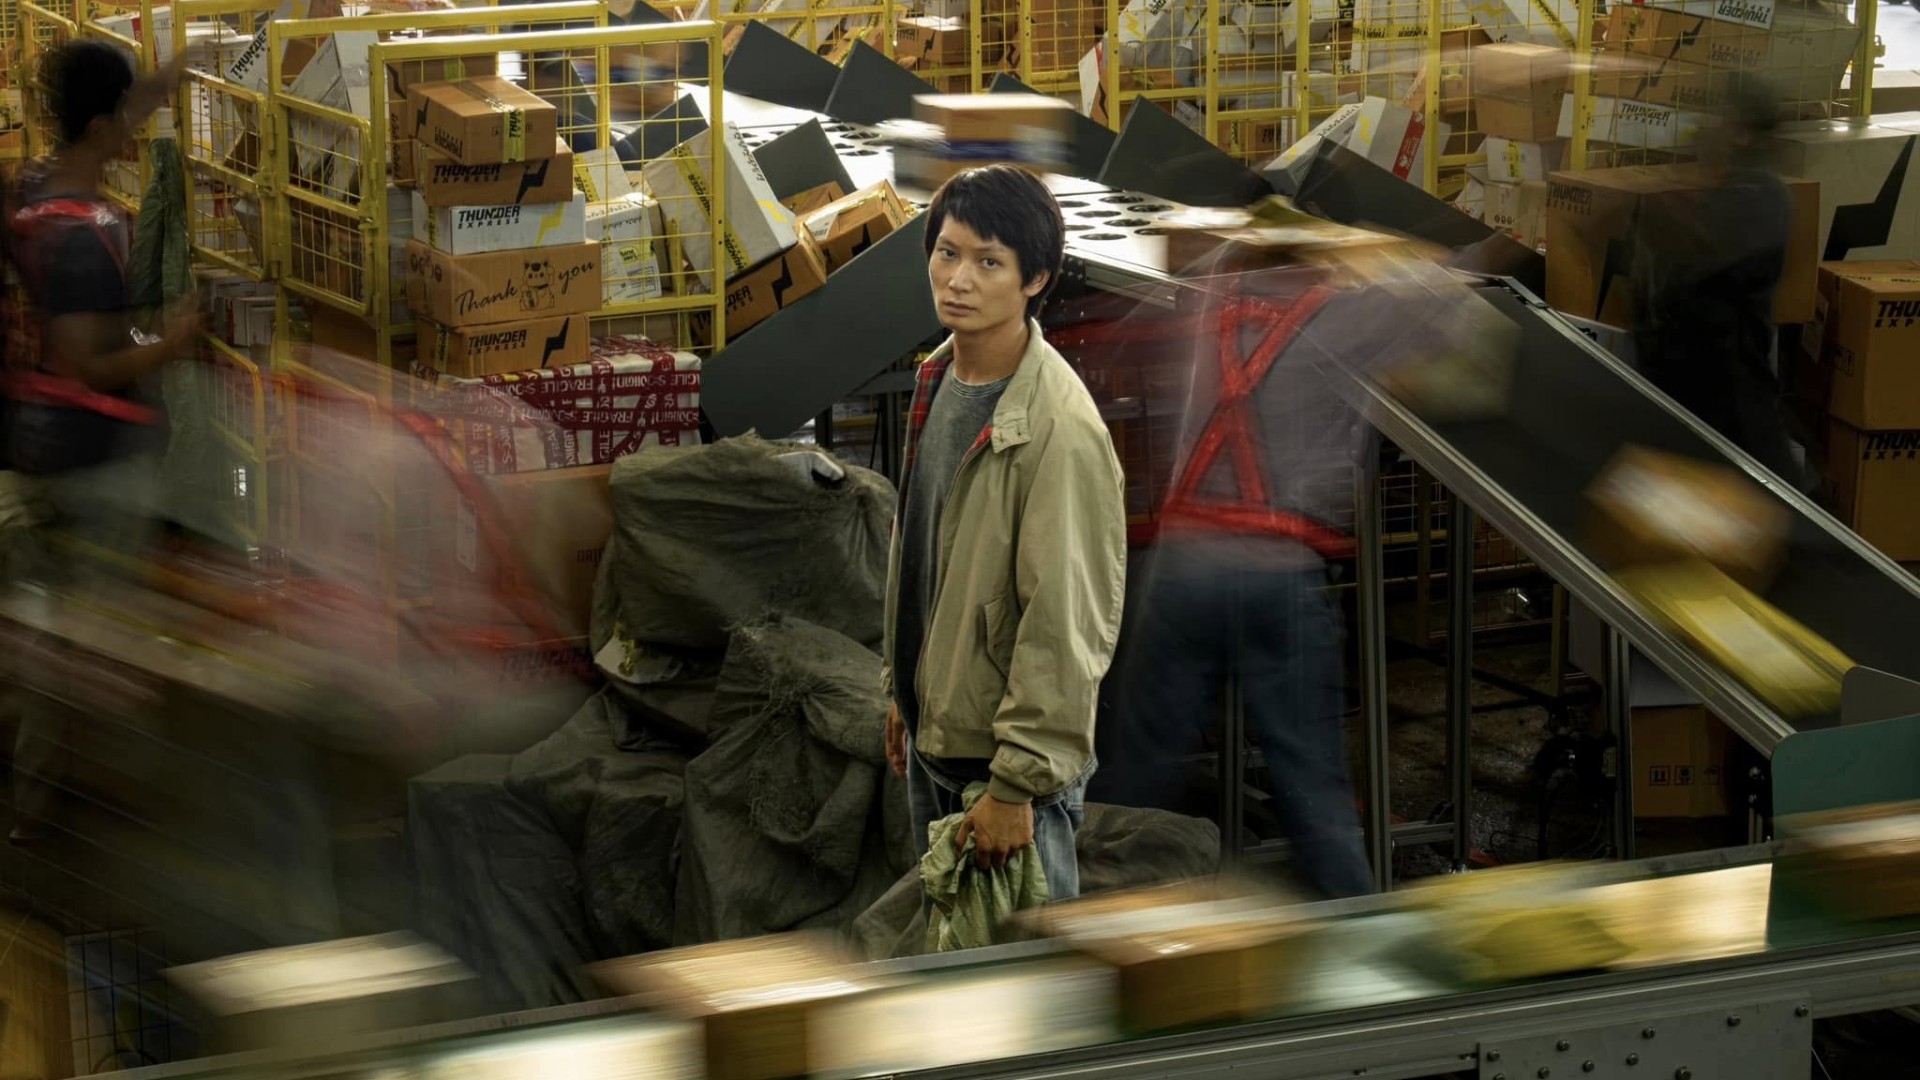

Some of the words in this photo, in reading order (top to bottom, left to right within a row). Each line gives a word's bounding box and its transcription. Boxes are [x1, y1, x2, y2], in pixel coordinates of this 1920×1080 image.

[457, 205, 521, 221] THUNDER
[457, 217, 520, 230] EXPRESS
[455, 278, 518, 317] Thank
[558, 261, 596, 292] you
[468, 329, 528, 348] THUNDER
[540, 378, 594, 395] FRAGILE
